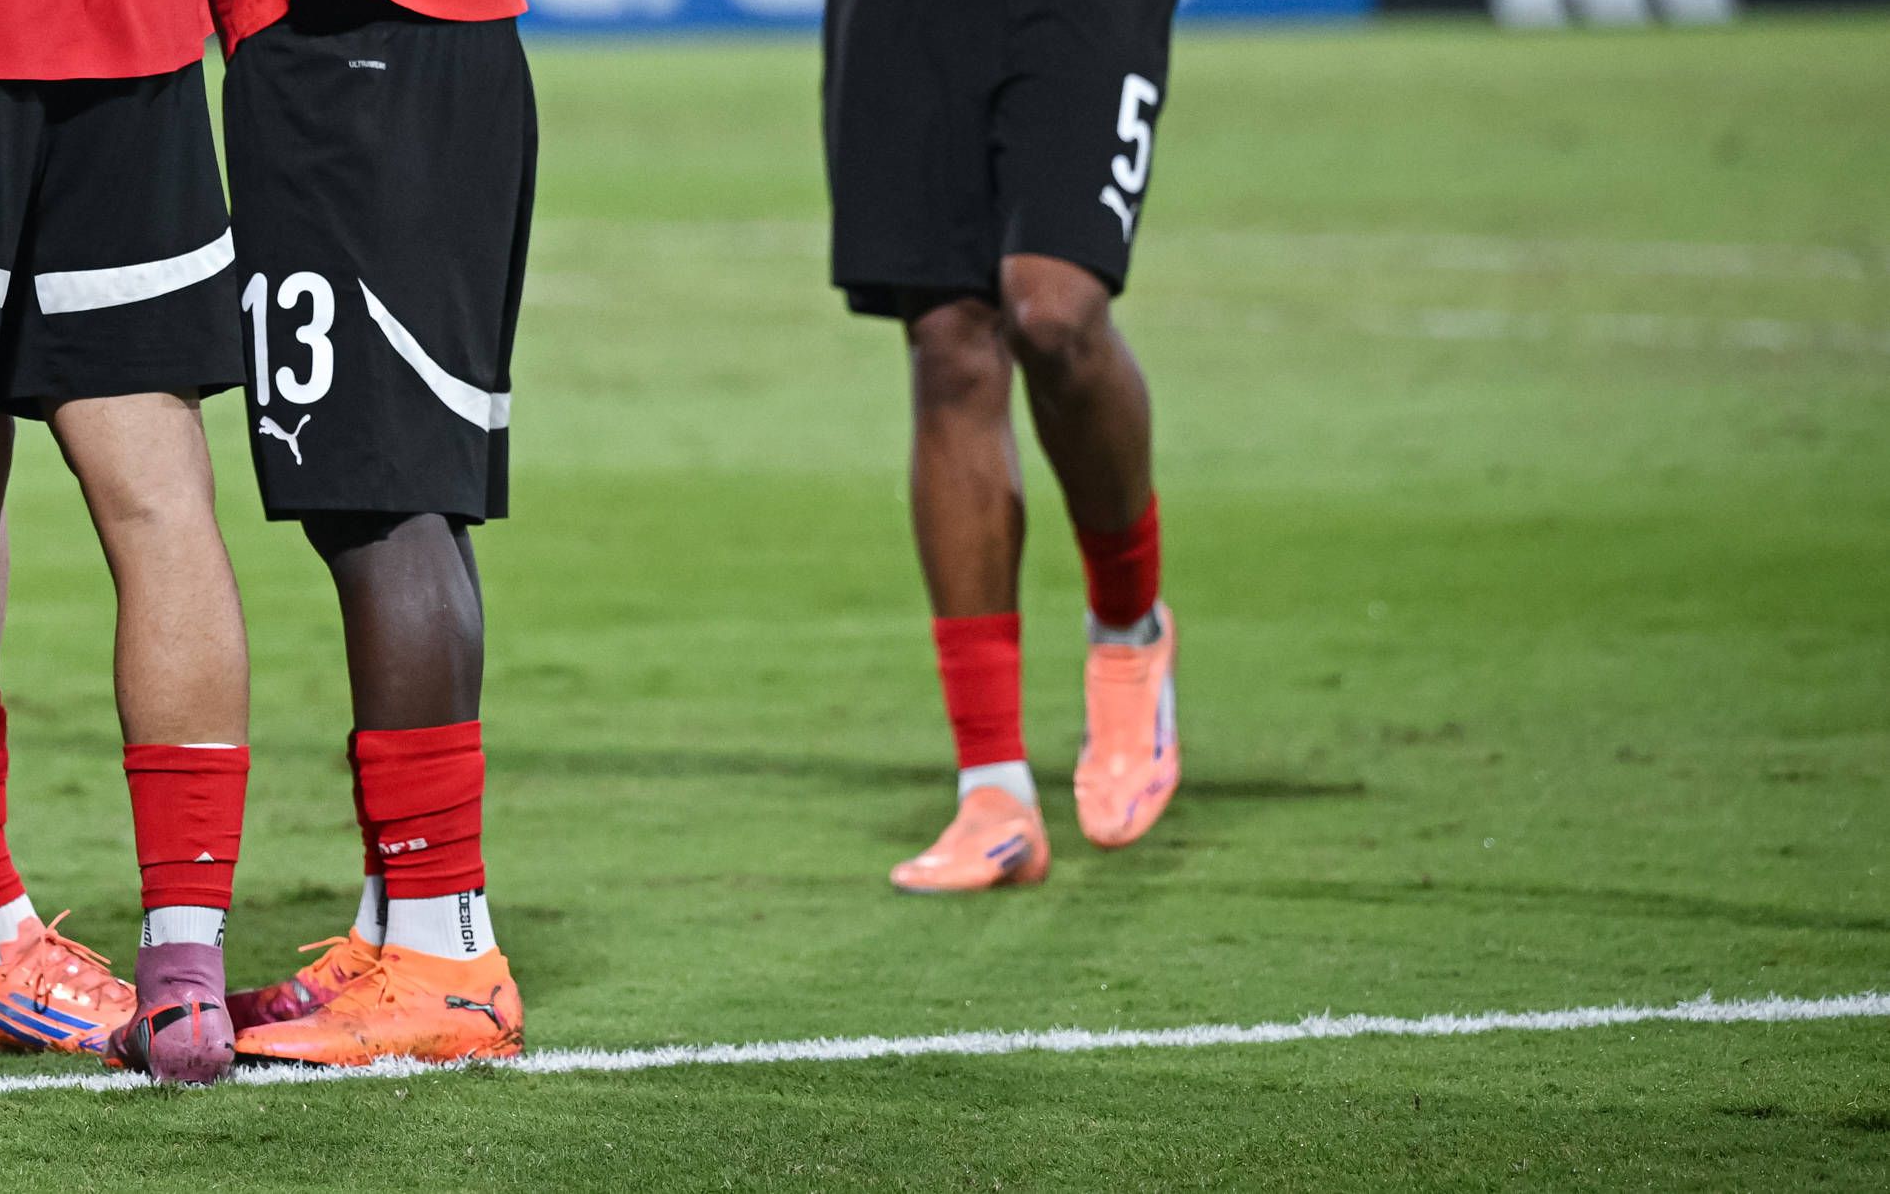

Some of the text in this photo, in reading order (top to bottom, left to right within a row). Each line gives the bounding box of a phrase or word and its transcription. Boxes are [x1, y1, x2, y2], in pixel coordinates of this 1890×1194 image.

[1111, 73, 1158, 194] 5
[241, 271, 336, 407] 13
[459, 891, 477, 953] DESIGN
